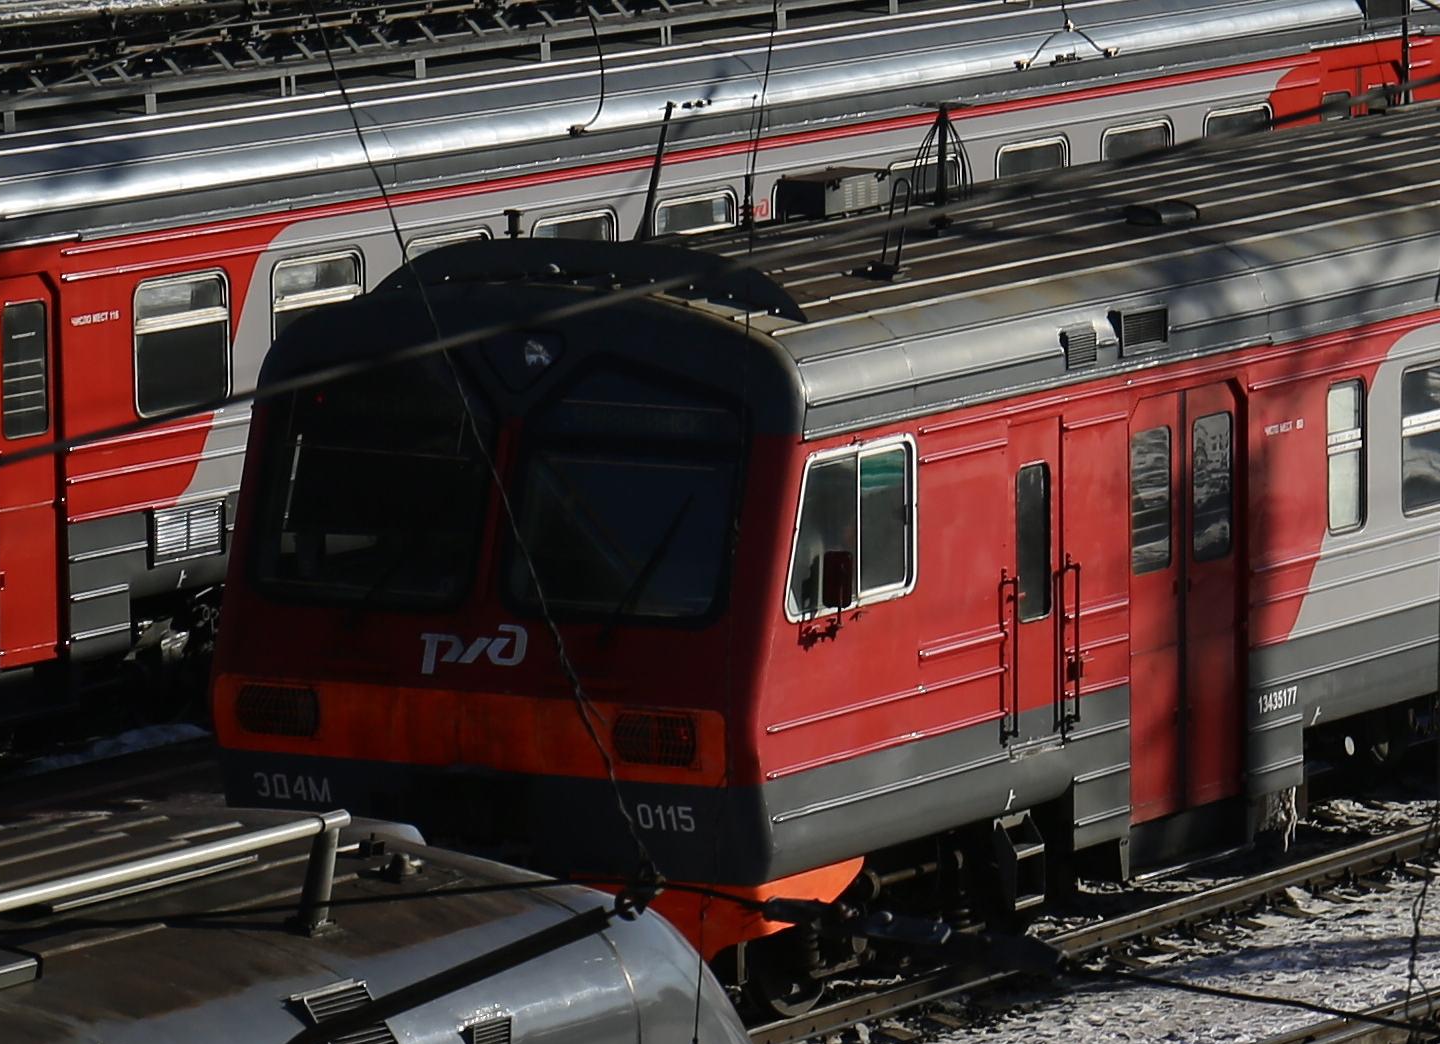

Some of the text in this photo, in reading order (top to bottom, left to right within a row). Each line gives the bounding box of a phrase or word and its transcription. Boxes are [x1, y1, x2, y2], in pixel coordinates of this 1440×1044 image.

[1257, 685, 1298, 714] 13435177
[253, 771, 332, 803] ЭД4М
[636, 803, 696, 833] 0115
